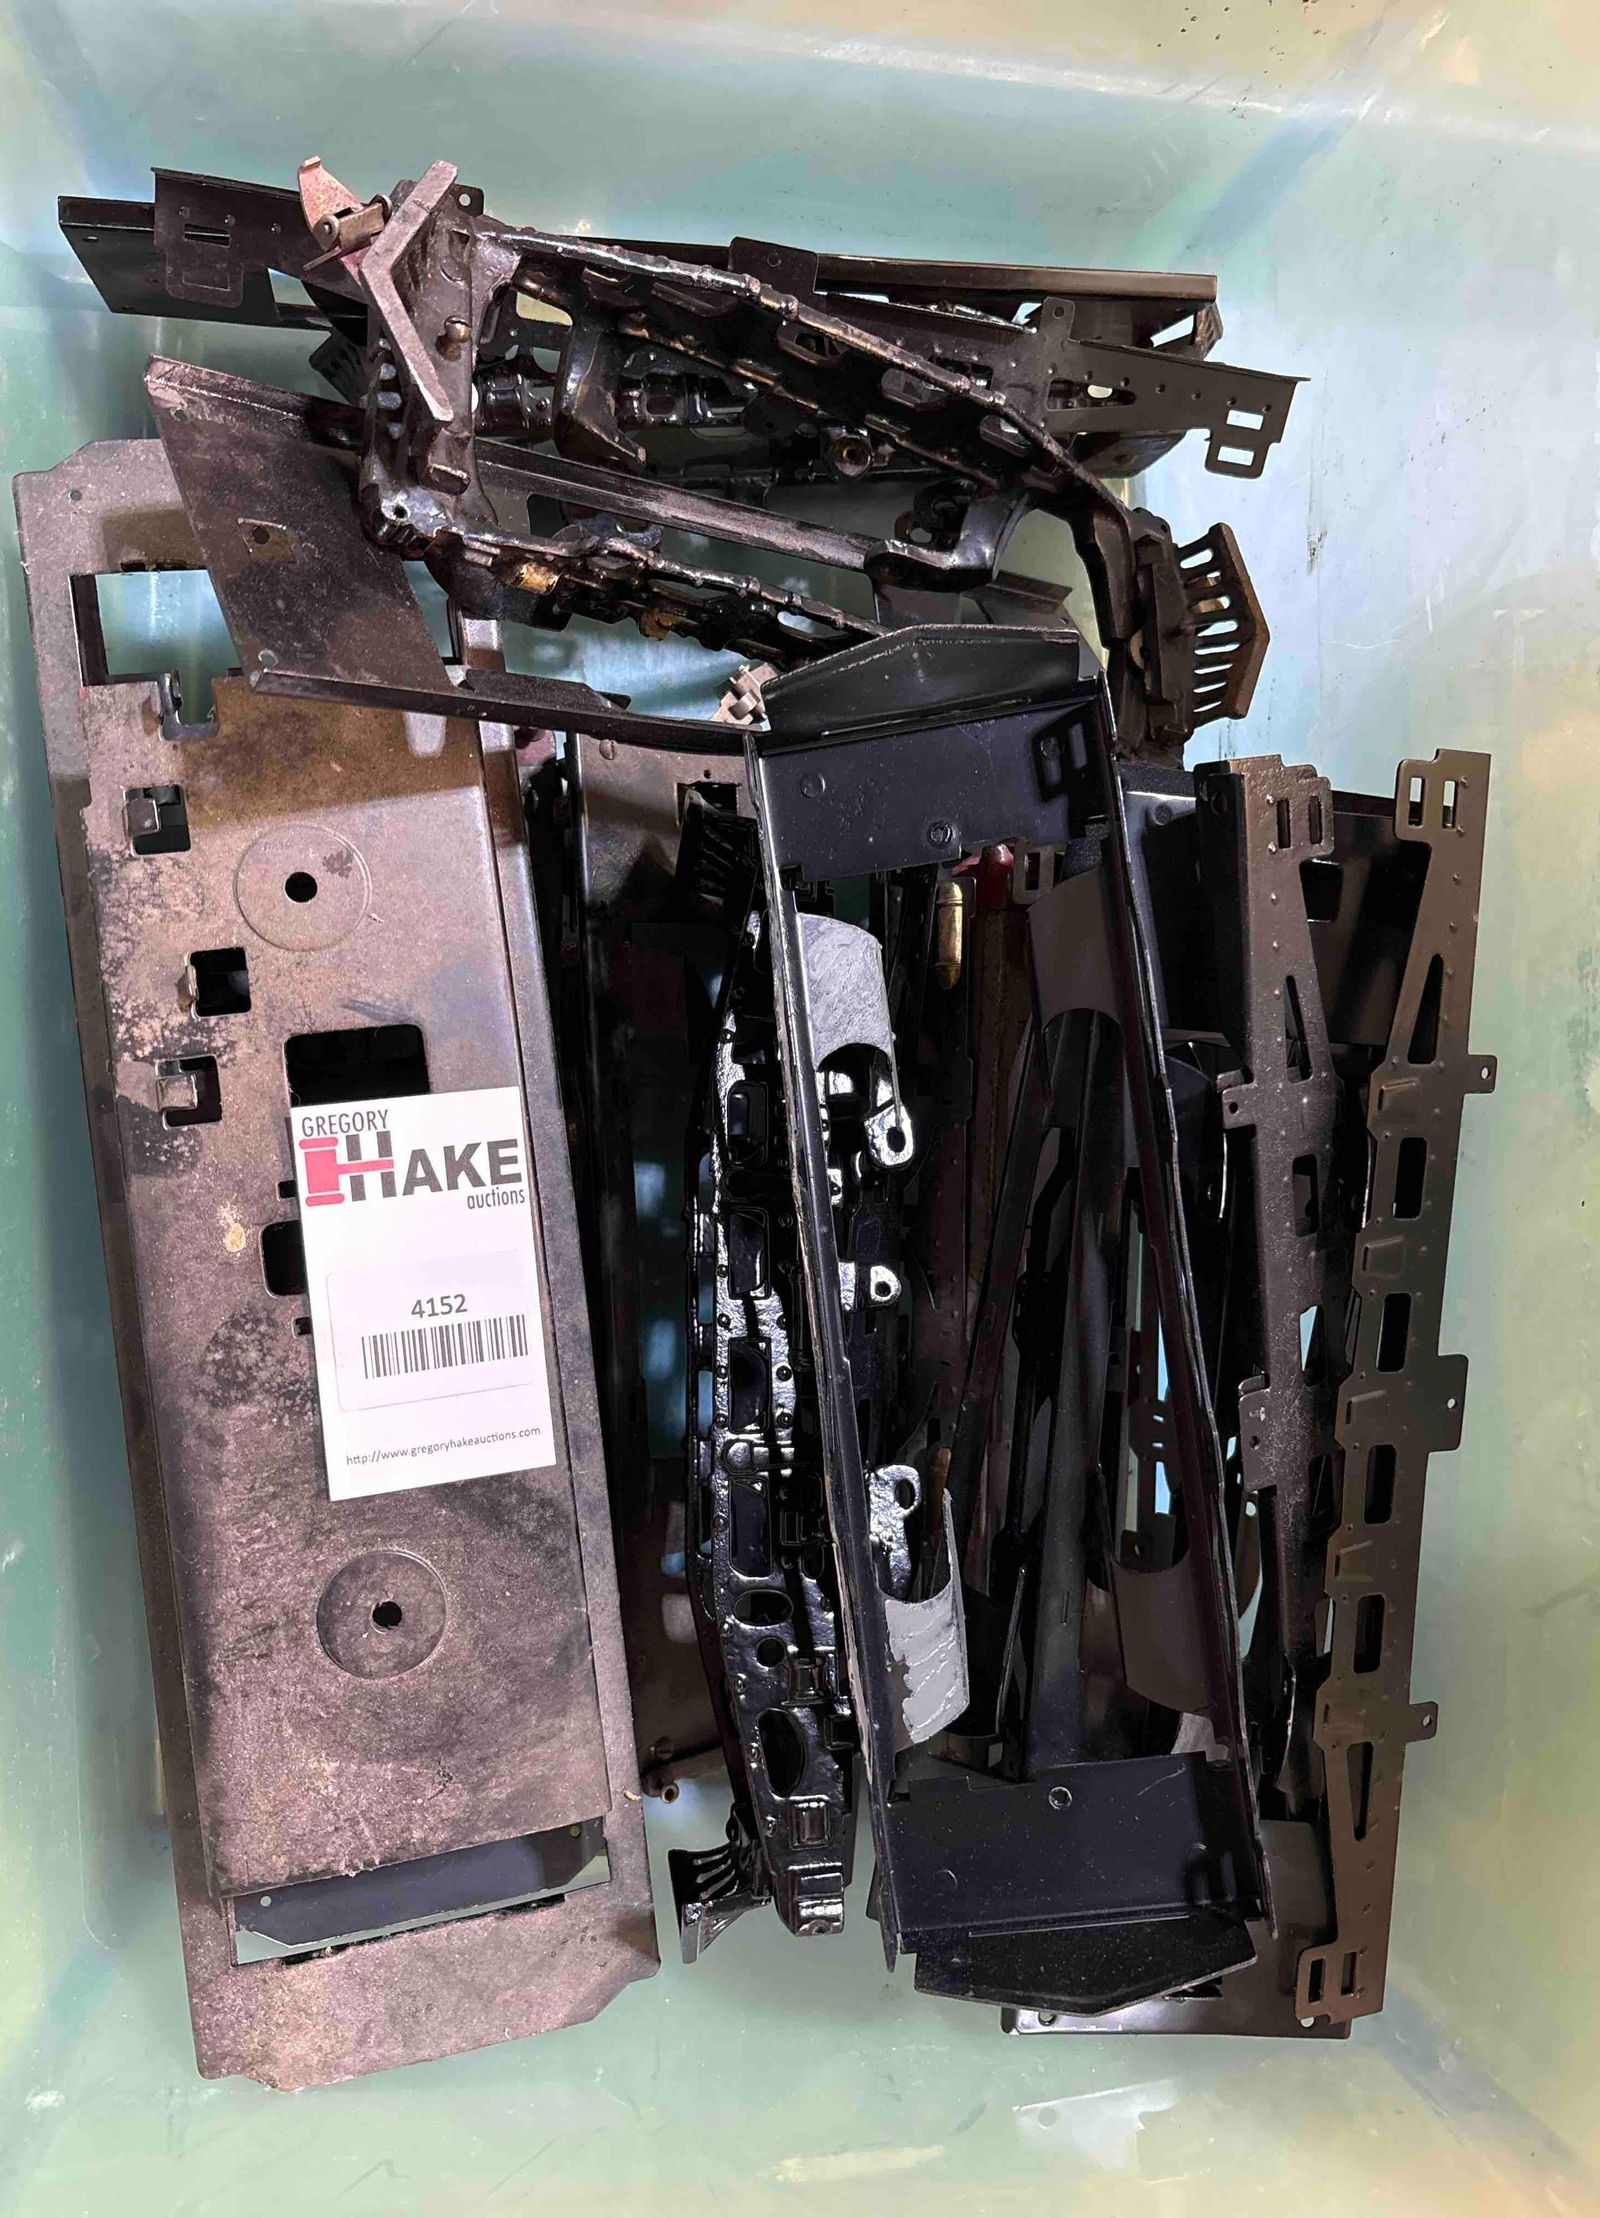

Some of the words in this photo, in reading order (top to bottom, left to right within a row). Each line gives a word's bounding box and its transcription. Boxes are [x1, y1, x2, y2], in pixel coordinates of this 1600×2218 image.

[301, 1109, 389, 1137] GREGORY
[345, 1131, 523, 1202] HAKE
[467, 1187, 526, 1210] auctions
[411, 1294, 468, 1319] 4152
[346, 1426, 541, 1466] http://www.gregoryhakeauctions.com
